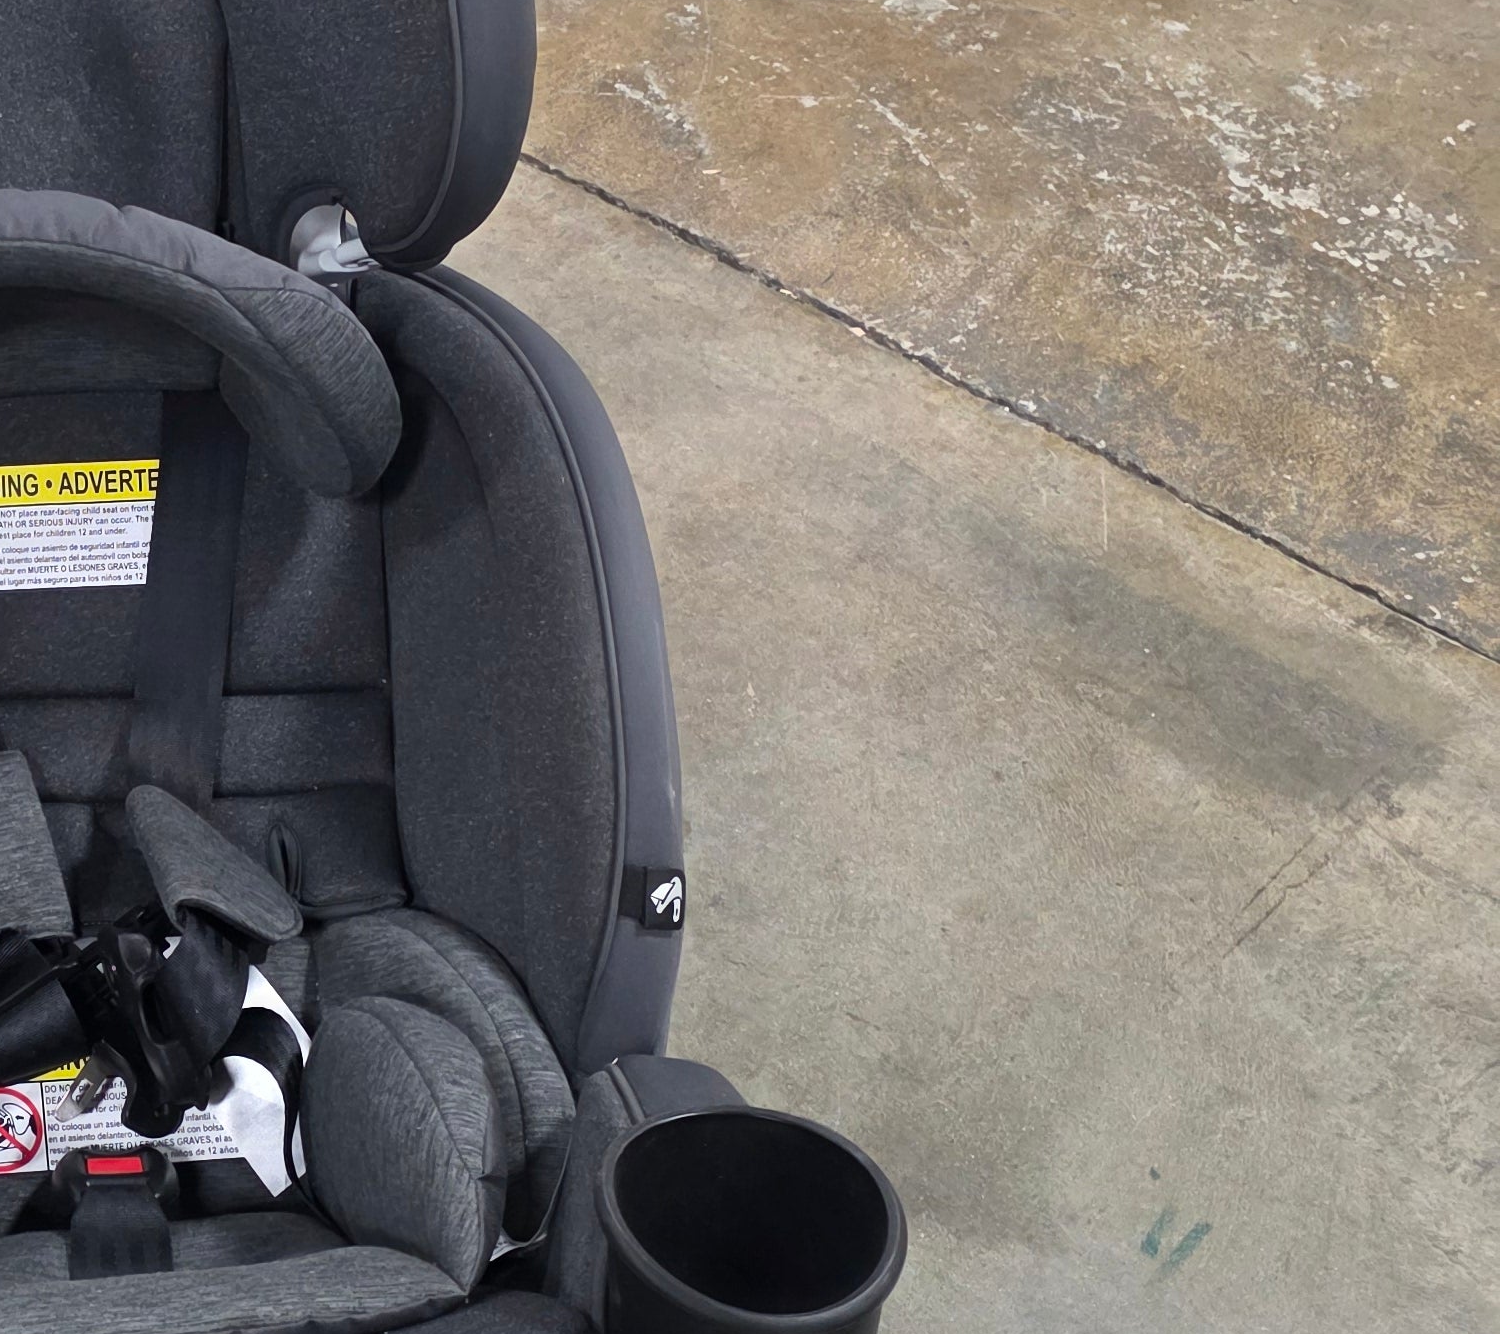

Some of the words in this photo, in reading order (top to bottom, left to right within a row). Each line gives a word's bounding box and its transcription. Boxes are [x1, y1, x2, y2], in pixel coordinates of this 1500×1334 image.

[59, 468, 159, 495] ADVERTE
[0, 510, 16, 518] NOT
[18, 509, 38, 519] place
[40, 507, 80, 517] rear-facing
[82, 506, 100, 514] child
[102, 506, 118, 514] seat
[15, 520, 27, 528] OR
[28, 518, 64, 528] SERIOUS
[65, 517, 94, 526] INJURY
[135, 515, 149, 523] The
[12, 531, 32, 540] place
[33, 530, 44, 538] for
[45, 529, 77, 537] children
[78, 528, 87, 536] 12
[88, 528, 102, 536] and
[104, 527, 128, 535] under.
[1, 546, 29, 555] coloque
[41, 544, 68, 552] asiento
[69, 543, 79, 551] de
[80, 541, 114, 552] seguridad
[116, 540, 140, 549] infantil
[0, 557, 6, 565] el
[7, 556, 33, 565] asiento
[34, 555, 67, 563] delantero
[69, 553, 79, 562] del
[117, 552, 131, 560] con
[27, 565, 59, 574] MUERTE
[60, 564, 67, 573] O
[68, 563, 106, 573] LESIONES
[0, 578, 6, 586] el
[7, 578, 26, 587] lugar
[43, 576, 69, 586] seguro
[69, 575, 86, 584] para
[88, 574, 99, 582] los
[123, 573, 133, 581] de
[135, 572, 143, 580] 12
[44, 1085, 57, 1094] DO
[47, 1123, 60, 1132] NO
[61, 1122, 92, 1131] coloque
[185, 1113, 211, 1121] infantil
[68, 1133, 95, 1142] asiento
[97, 1131, 133, 1140] delantero
[215, 1134, 222, 1143] el
[195, 1148, 205, 1156] de
[208, 1146, 217, 1155] 12
